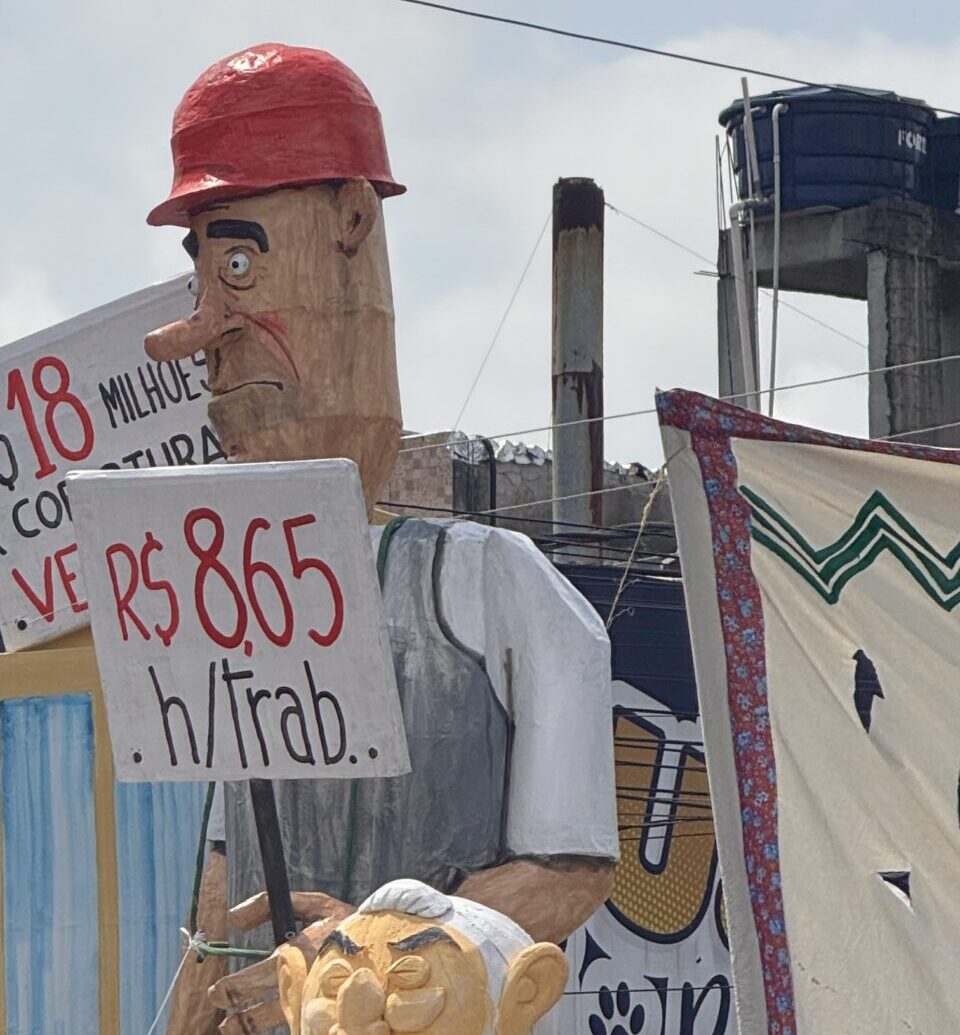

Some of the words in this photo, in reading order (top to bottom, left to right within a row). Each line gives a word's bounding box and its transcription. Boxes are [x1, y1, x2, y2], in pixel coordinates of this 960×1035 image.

[6, 356, 95, 480] 18
[105, 531, 181, 647] R$
[183, 507, 345, 657] 8,65
